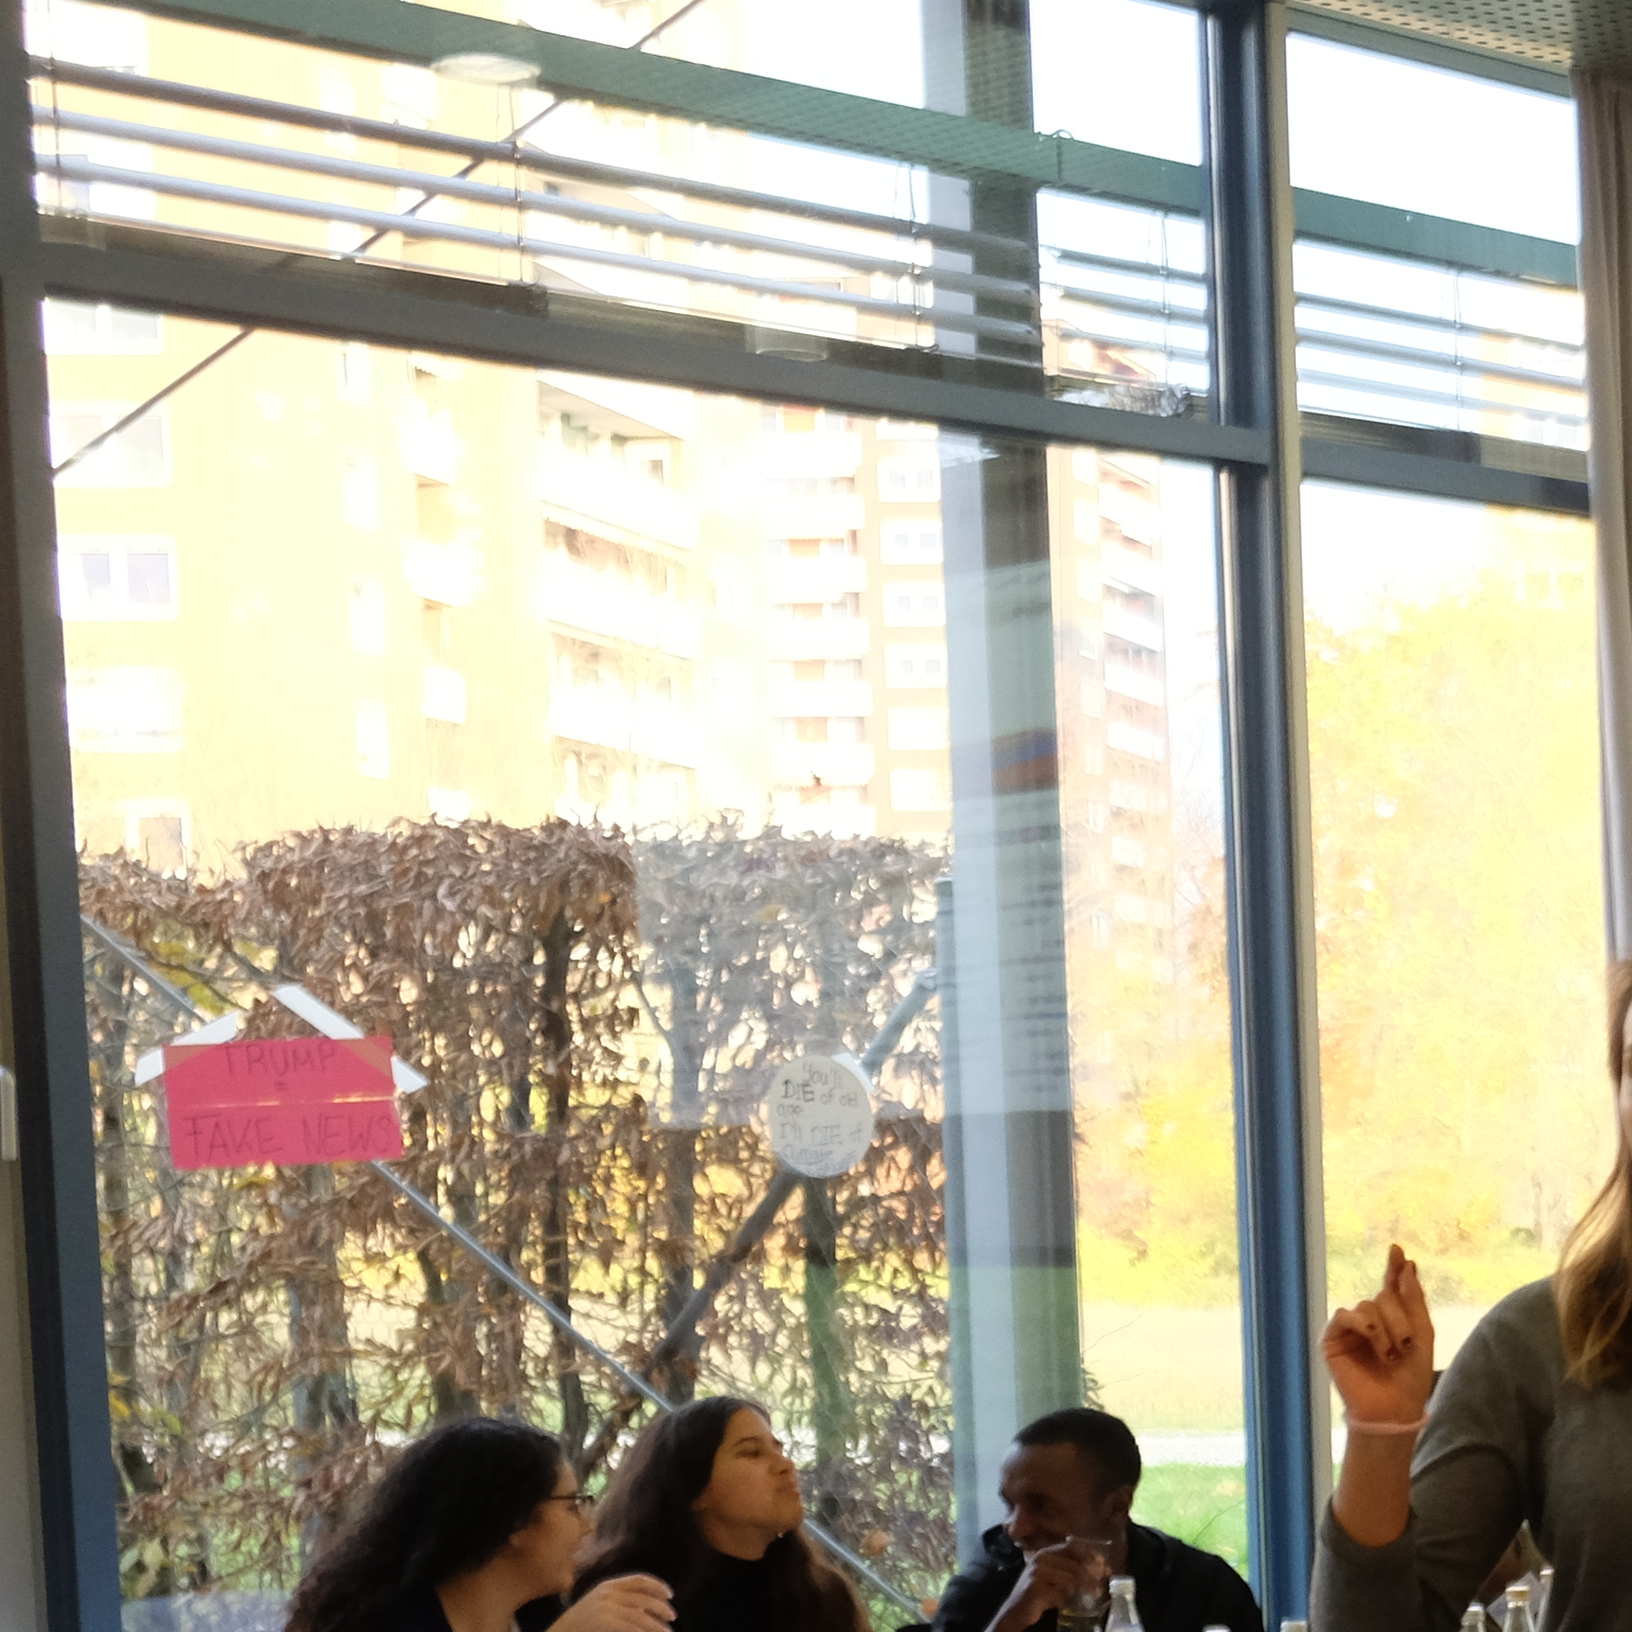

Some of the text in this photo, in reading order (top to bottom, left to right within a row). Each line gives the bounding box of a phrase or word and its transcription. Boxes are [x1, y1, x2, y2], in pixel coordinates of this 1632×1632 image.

[220, 1042, 336, 1075] TRUMP
[782, 1079, 814, 1103] DIE
[182, 1111, 391, 1162] FAKE NEWS
